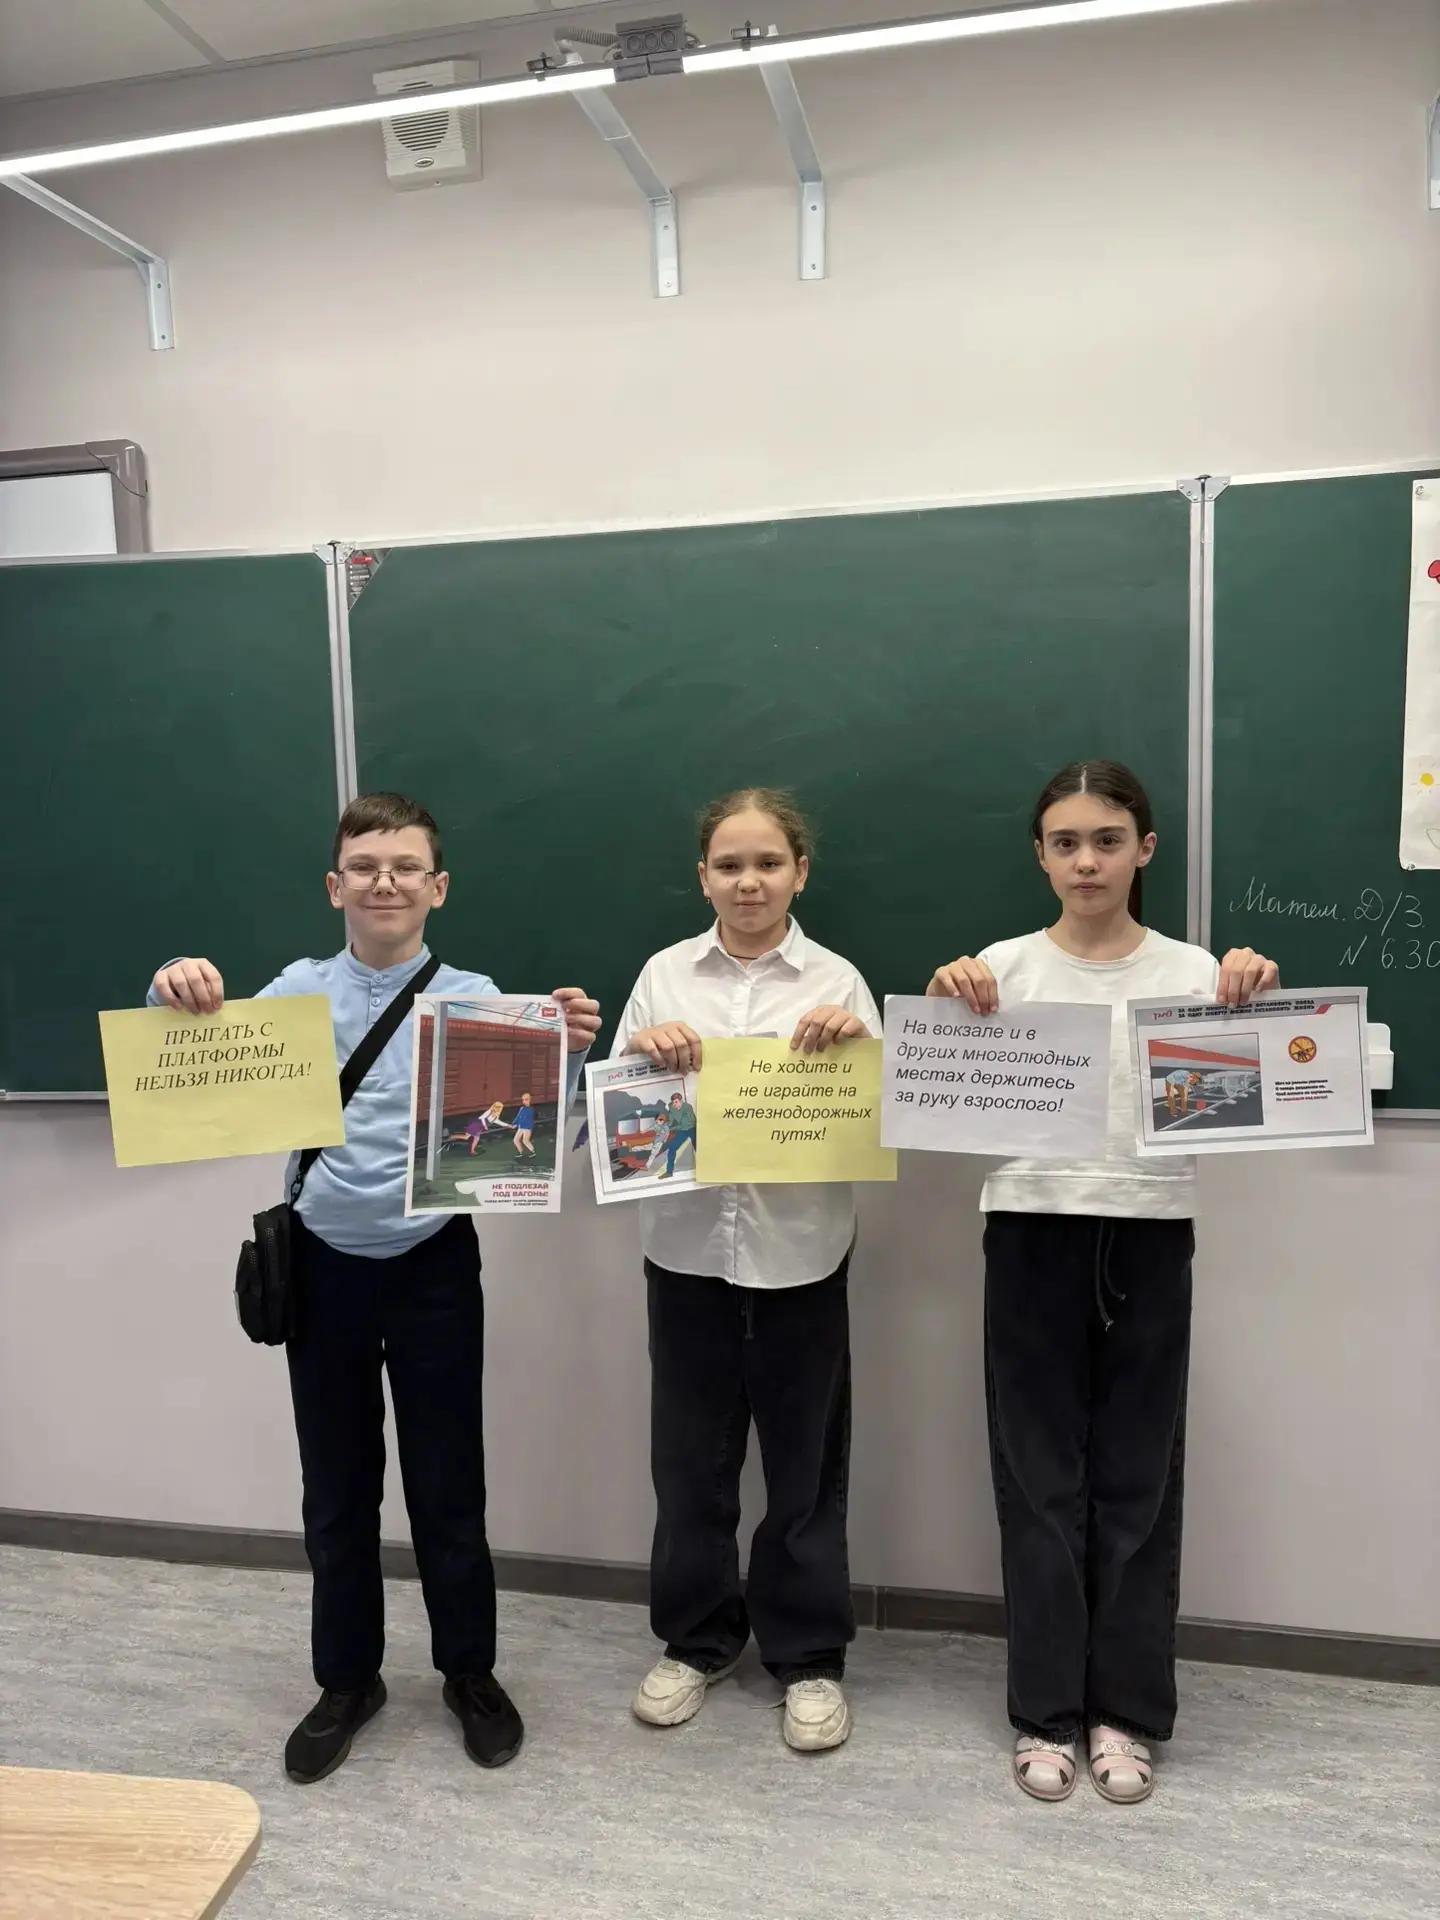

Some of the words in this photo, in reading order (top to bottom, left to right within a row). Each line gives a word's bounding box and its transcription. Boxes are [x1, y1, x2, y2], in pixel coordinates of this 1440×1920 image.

[164, 1024, 254, 1045] ПРЫГАТЬ
[260, 1022, 273, 1037] С
[902, 1019, 926, 1035] На
[932, 1024, 1004, 1039] вокзале
[1010, 1028, 1021, 1040] и
[1025, 1029, 1037, 1041] в
[157, 1042, 285, 1068] ПЛАТФОРМЫ
[896, 1042, 957, 1062] других
[962, 1049, 1091, 1067] многолюдных
[135, 1071, 208, 1091] НЕЛЬЗЯ
[214, 1062, 312, 1084] НИКОГДА!
[749, 1060, 772, 1074] Не
[777, 1060, 838, 1074] ходите
[842, 1063, 853, 1074] и
[895, 1068, 965, 1083] местах
[970, 1069, 1075, 1090] держитесь
[739, 1086, 759, 1097] не
[763, 1084, 834, 1100] играйте
[838, 1086, 857, 1097] на
[894, 1091, 915, 1103] за
[919, 1093, 960, 1109] руку
[963, 1095, 1064, 1113] взрослого!
[722, 1105, 872, 1122] железнодорожных
[770, 1127, 827, 1144] путях!
